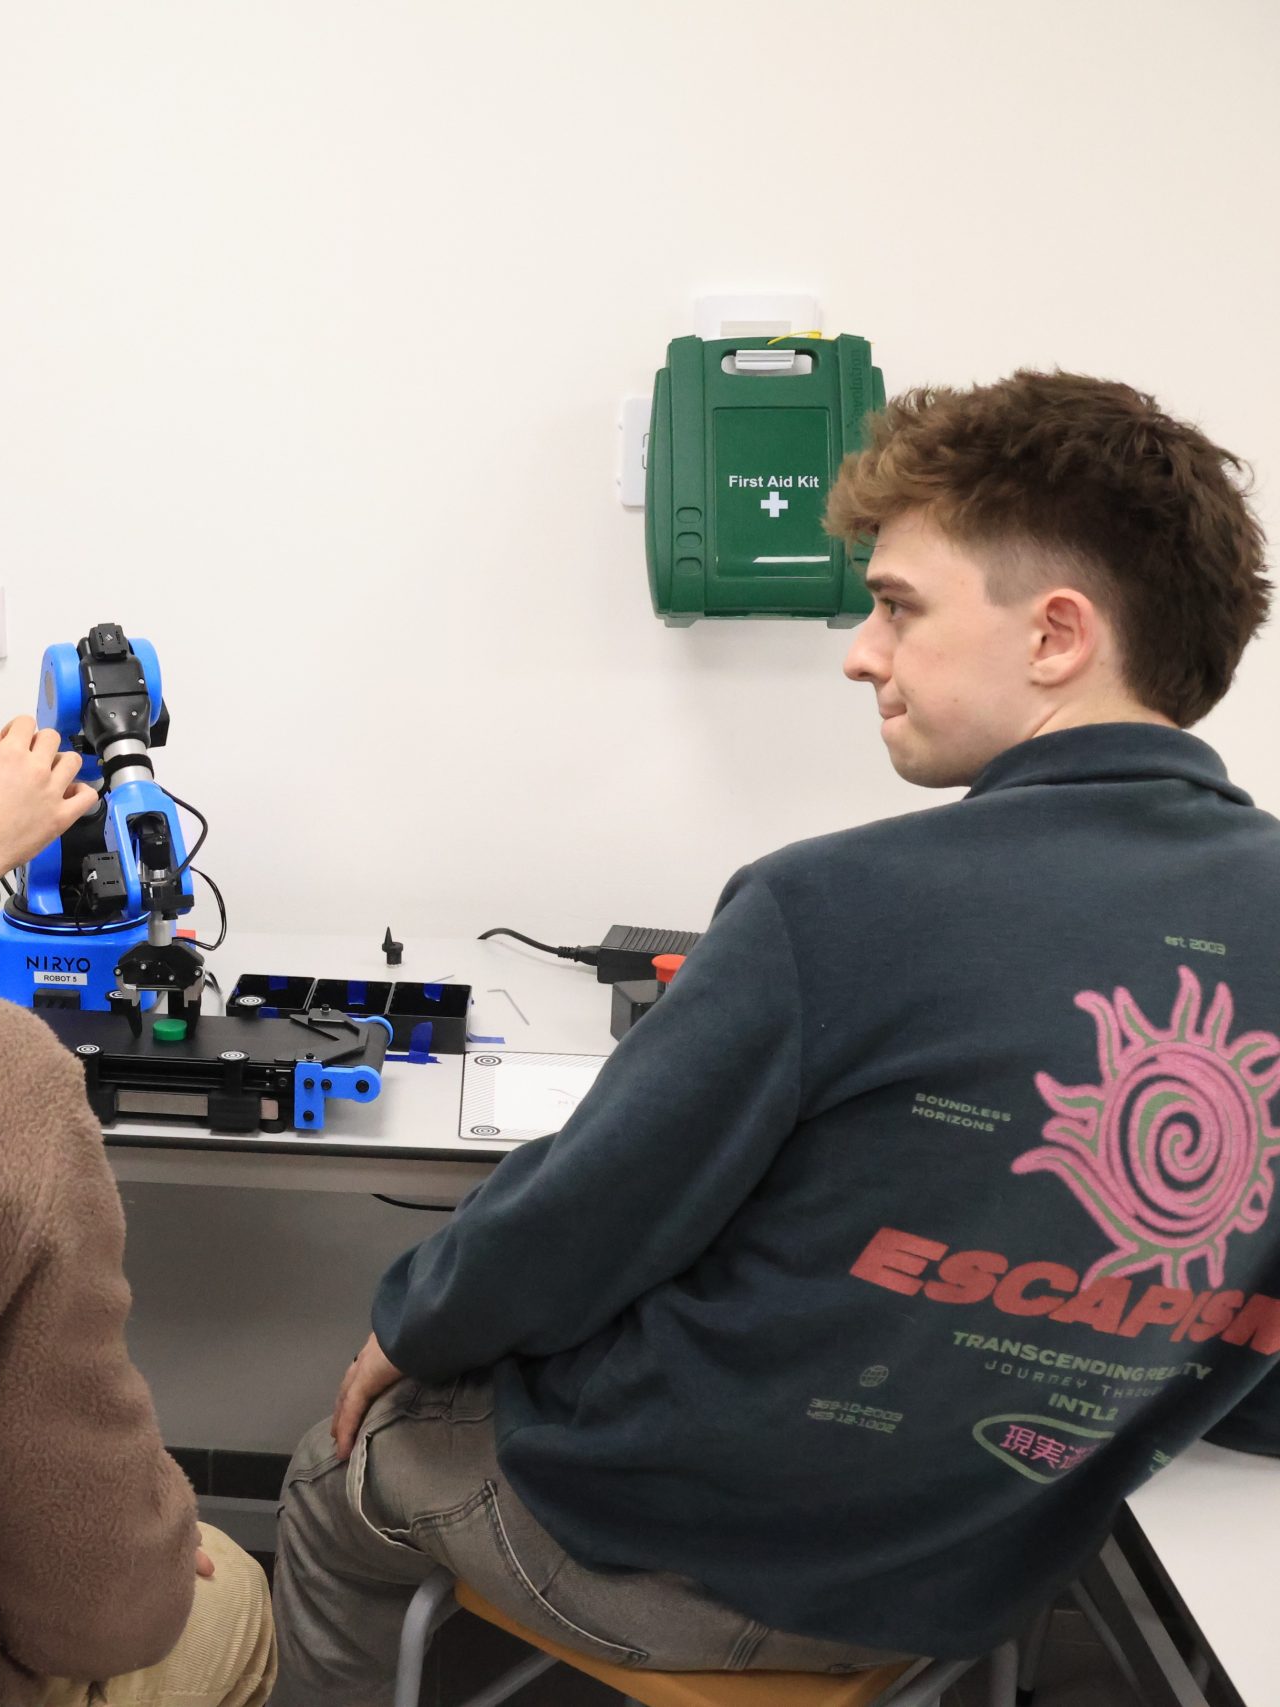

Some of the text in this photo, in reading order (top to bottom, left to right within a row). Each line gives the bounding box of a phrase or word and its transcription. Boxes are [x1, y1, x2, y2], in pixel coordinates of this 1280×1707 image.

[729, 475, 820, 488] First Aid Kit
[26, 956, 91, 973] NIRYO
[43, 974, 71, 983] ROBOT
[912, 1105, 995, 1132] HORIZONS
[915, 1093, 1012, 1122] BOUNDLESS
[984, 1360, 1087, 1389] JOURNEY
